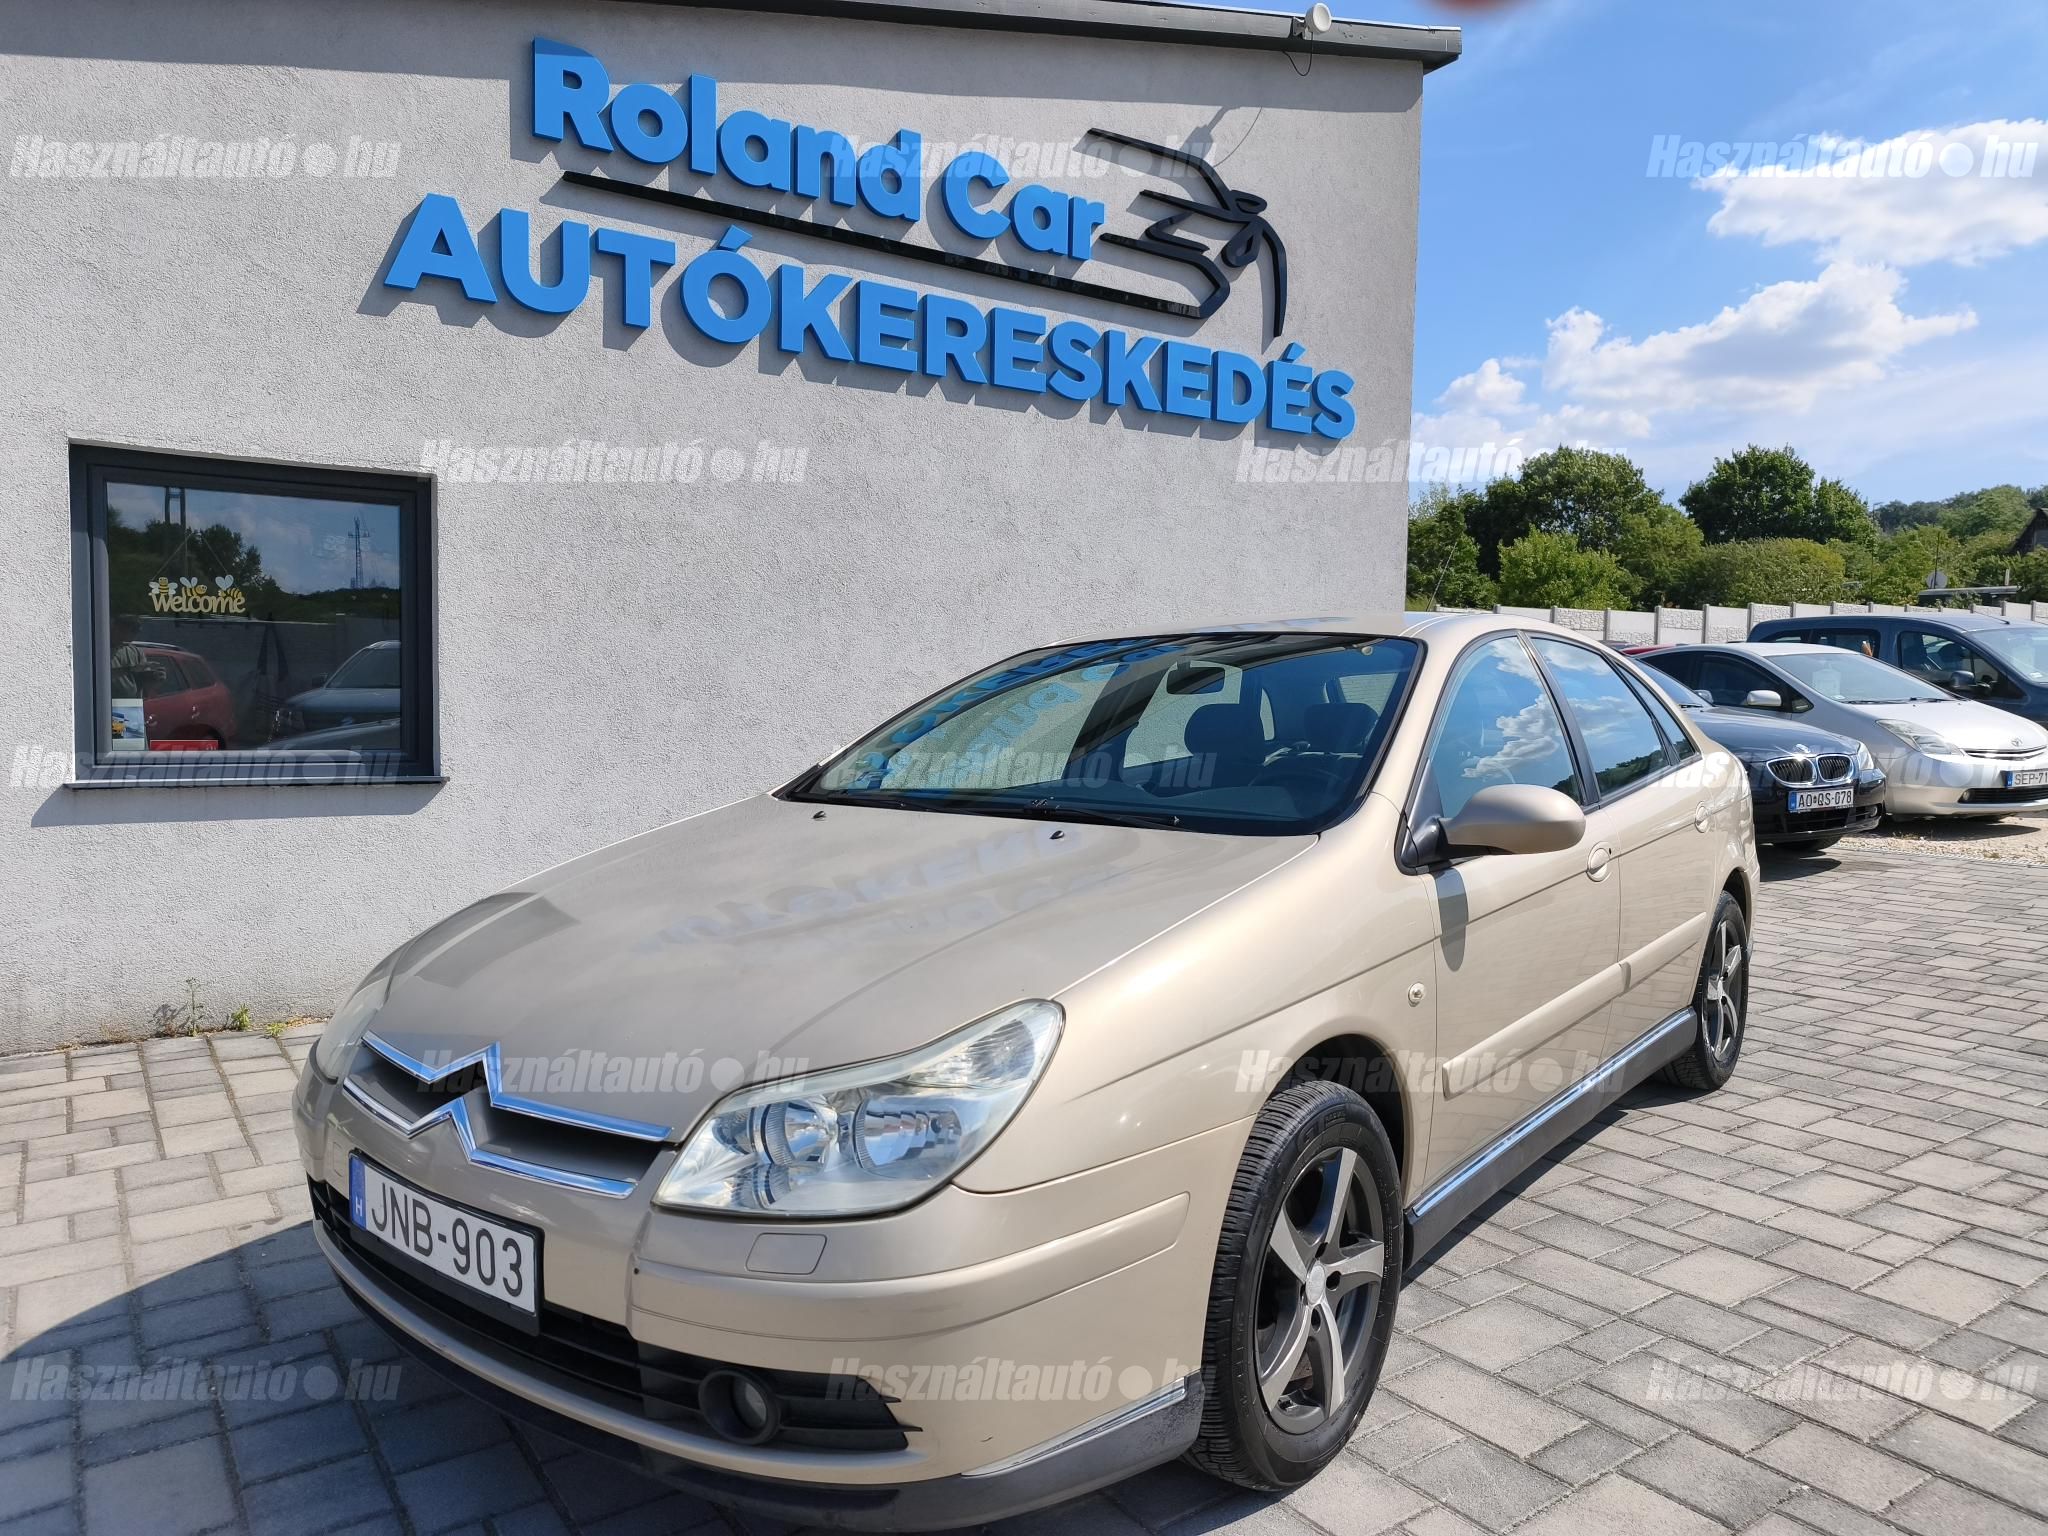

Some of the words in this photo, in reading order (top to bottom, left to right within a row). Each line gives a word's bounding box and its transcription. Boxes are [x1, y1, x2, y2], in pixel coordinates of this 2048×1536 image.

[532, 37, 921, 223] Roland
[942, 150, 1104, 262] Car
[384, 192, 1356, 440] AUTÓKERESKEDÉS
[371, 1182, 523, 1298] JNB-903
